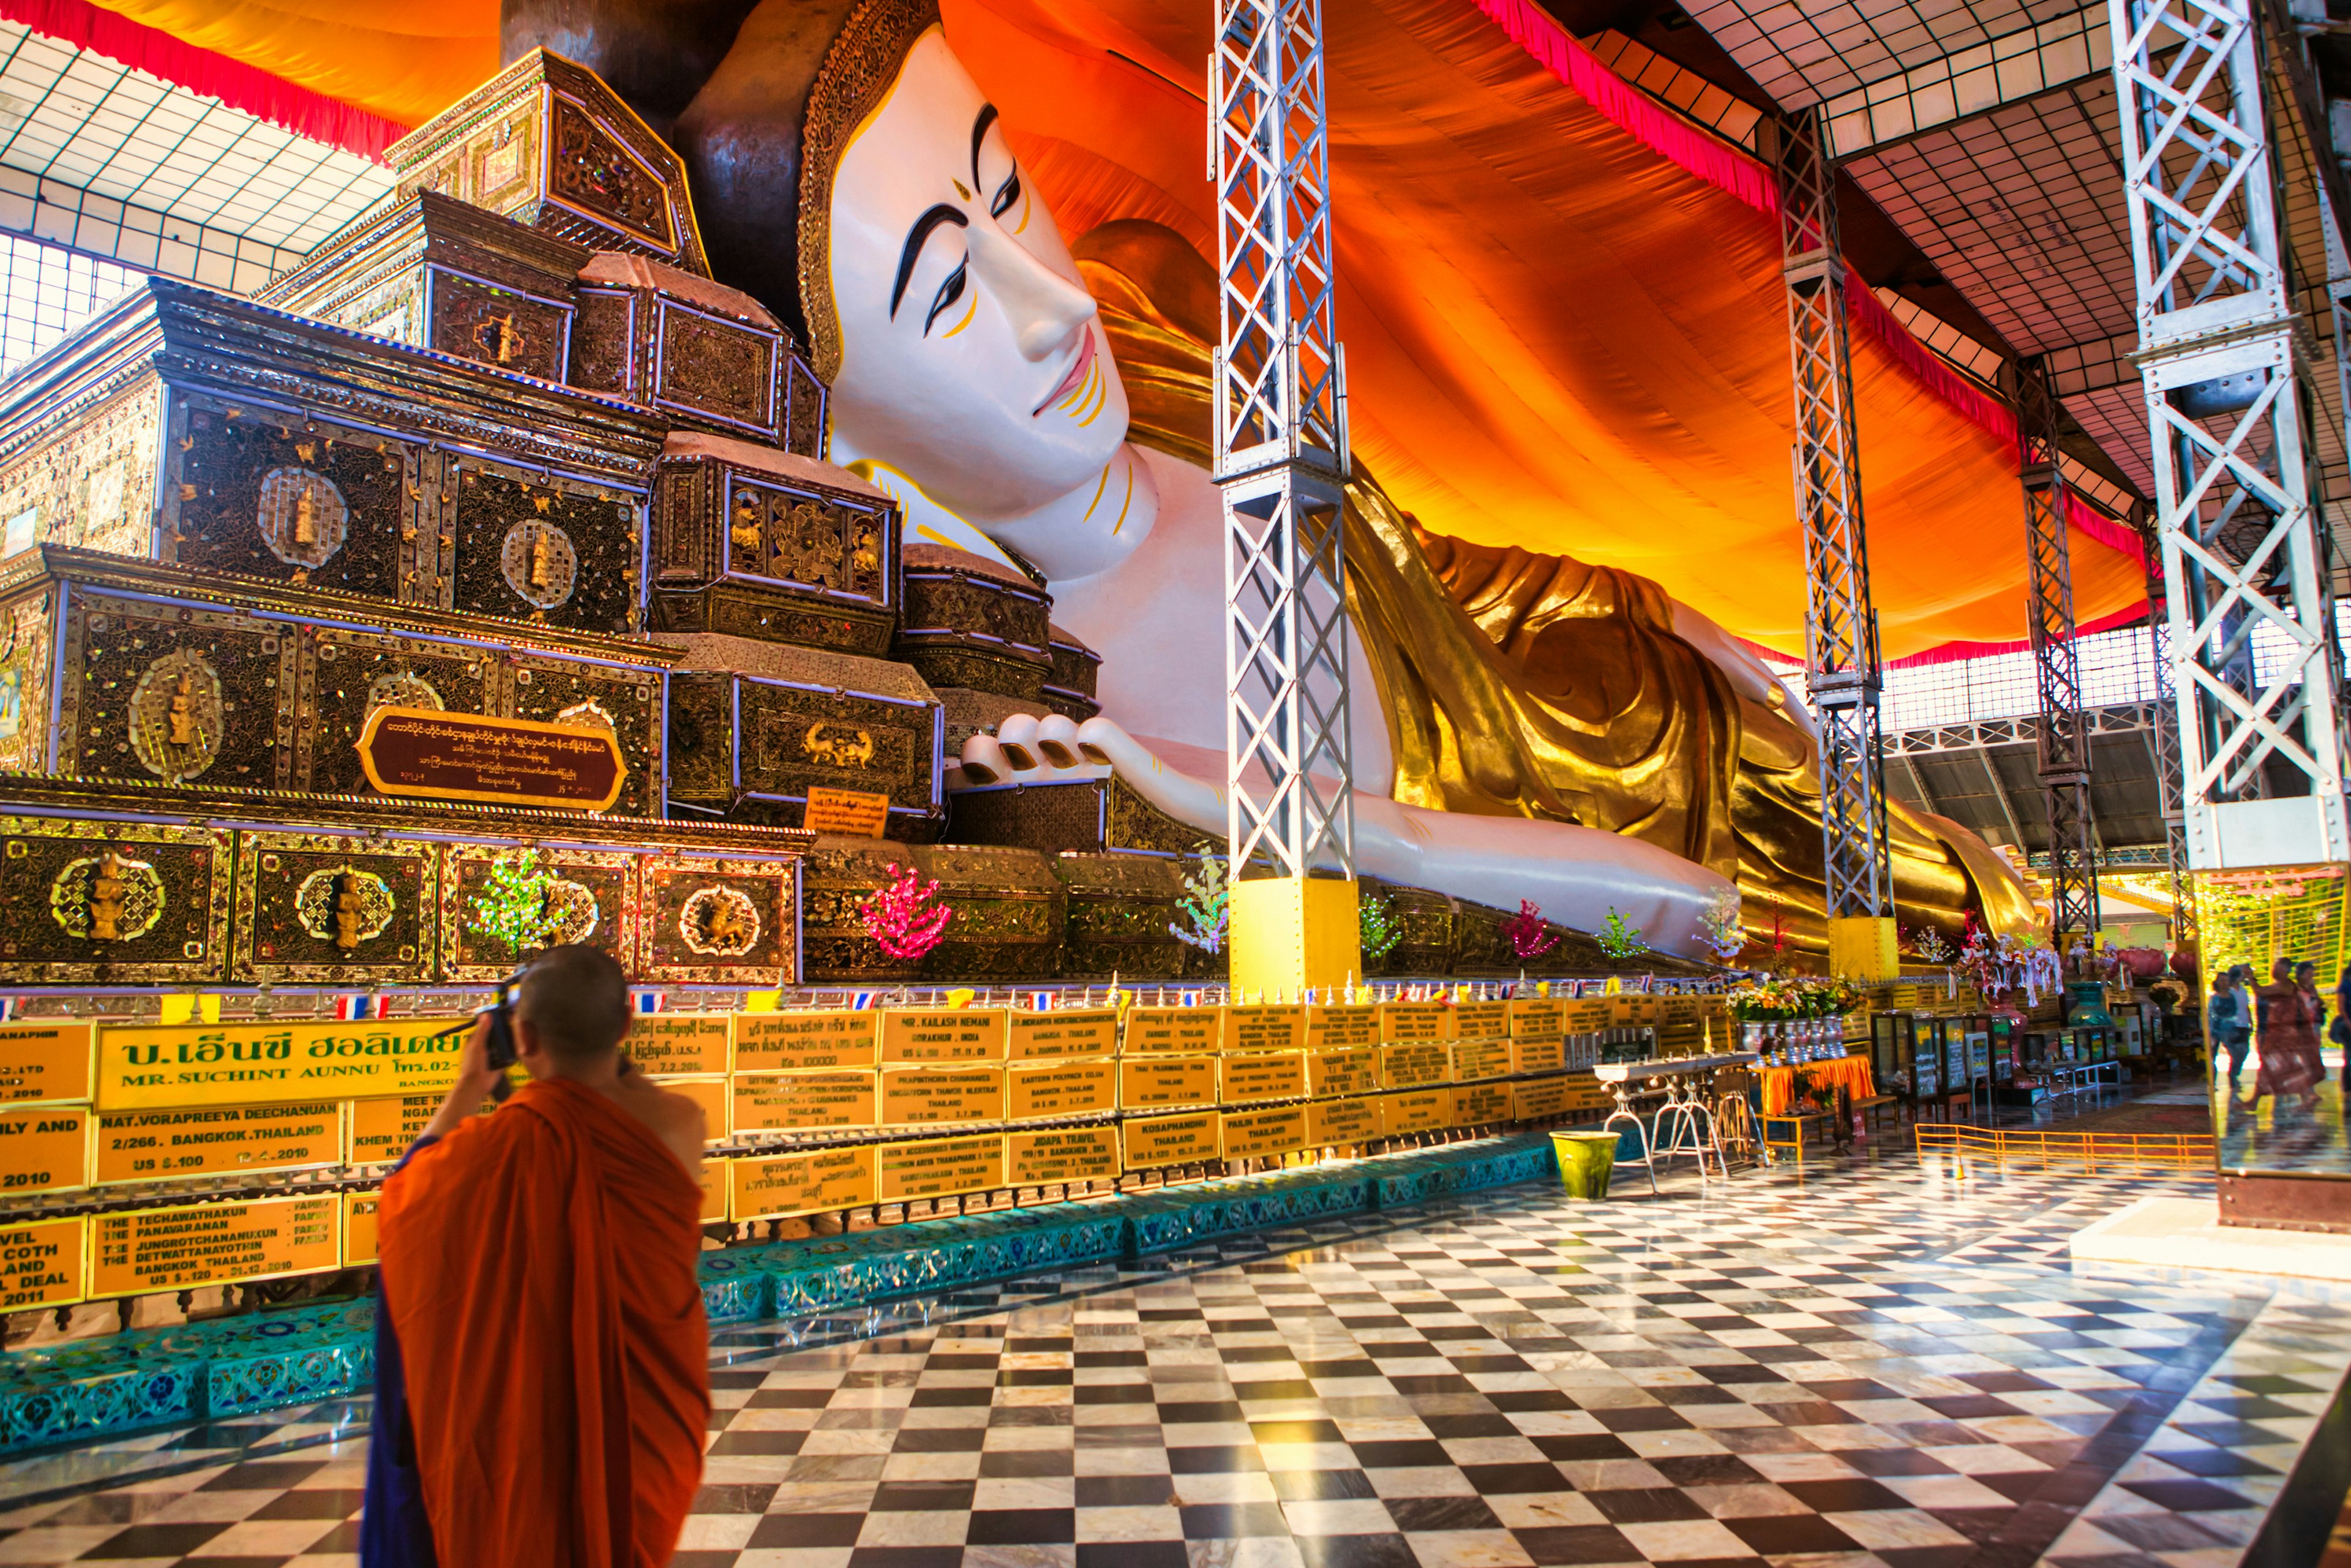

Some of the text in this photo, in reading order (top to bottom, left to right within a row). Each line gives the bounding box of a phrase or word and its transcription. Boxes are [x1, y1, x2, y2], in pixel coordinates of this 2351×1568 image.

[921, 1017, 957, 1027] KAILASH
[960, 1016, 991, 1027] NEMANI
[961, 1033, 980, 1041] INDIA
[178, 1067, 291, 1084] SUCHINT
[299, 1064, 380, 1078] AUNNU
[1021, 1076, 1051, 1085] EASTERN
[1053, 1072, 1082, 1081] POLYPACK
[399, 1078, 460, 1087] BANGKO
[1157, 1078, 1184, 1086] THAILAND
[1032, 1084, 1095, 1097] BANGKOK THAILAND
[244, 1104, 337, 1120] DEECHANUAN
[36, 1120, 78, 1133] AND
[1142, 1120, 1207, 1134] KOSAPHANDHU
[1228, 1119, 1253, 1128] PAILIN
[1248, 1126, 1286, 1139] THAILAND
[355, 1135, 392, 1146] KHEM
[1033, 1133, 1097, 1147] JIDAPA TRAVEL
[1153, 1134, 1195, 1146] THAILAND
[1050, 1146, 1087, 1157] BANGKHEN
[133, 1159, 156, 1171] US
[137, 1207, 247, 1225] TECHAWATHAKUN
[4, 1244, 58, 1260] COTH
[135, 1252, 265, 1276] BANGKOK THAILAND
[20, 1273, 69, 1289] DEAL
[150, 1275, 167, 1285] US
